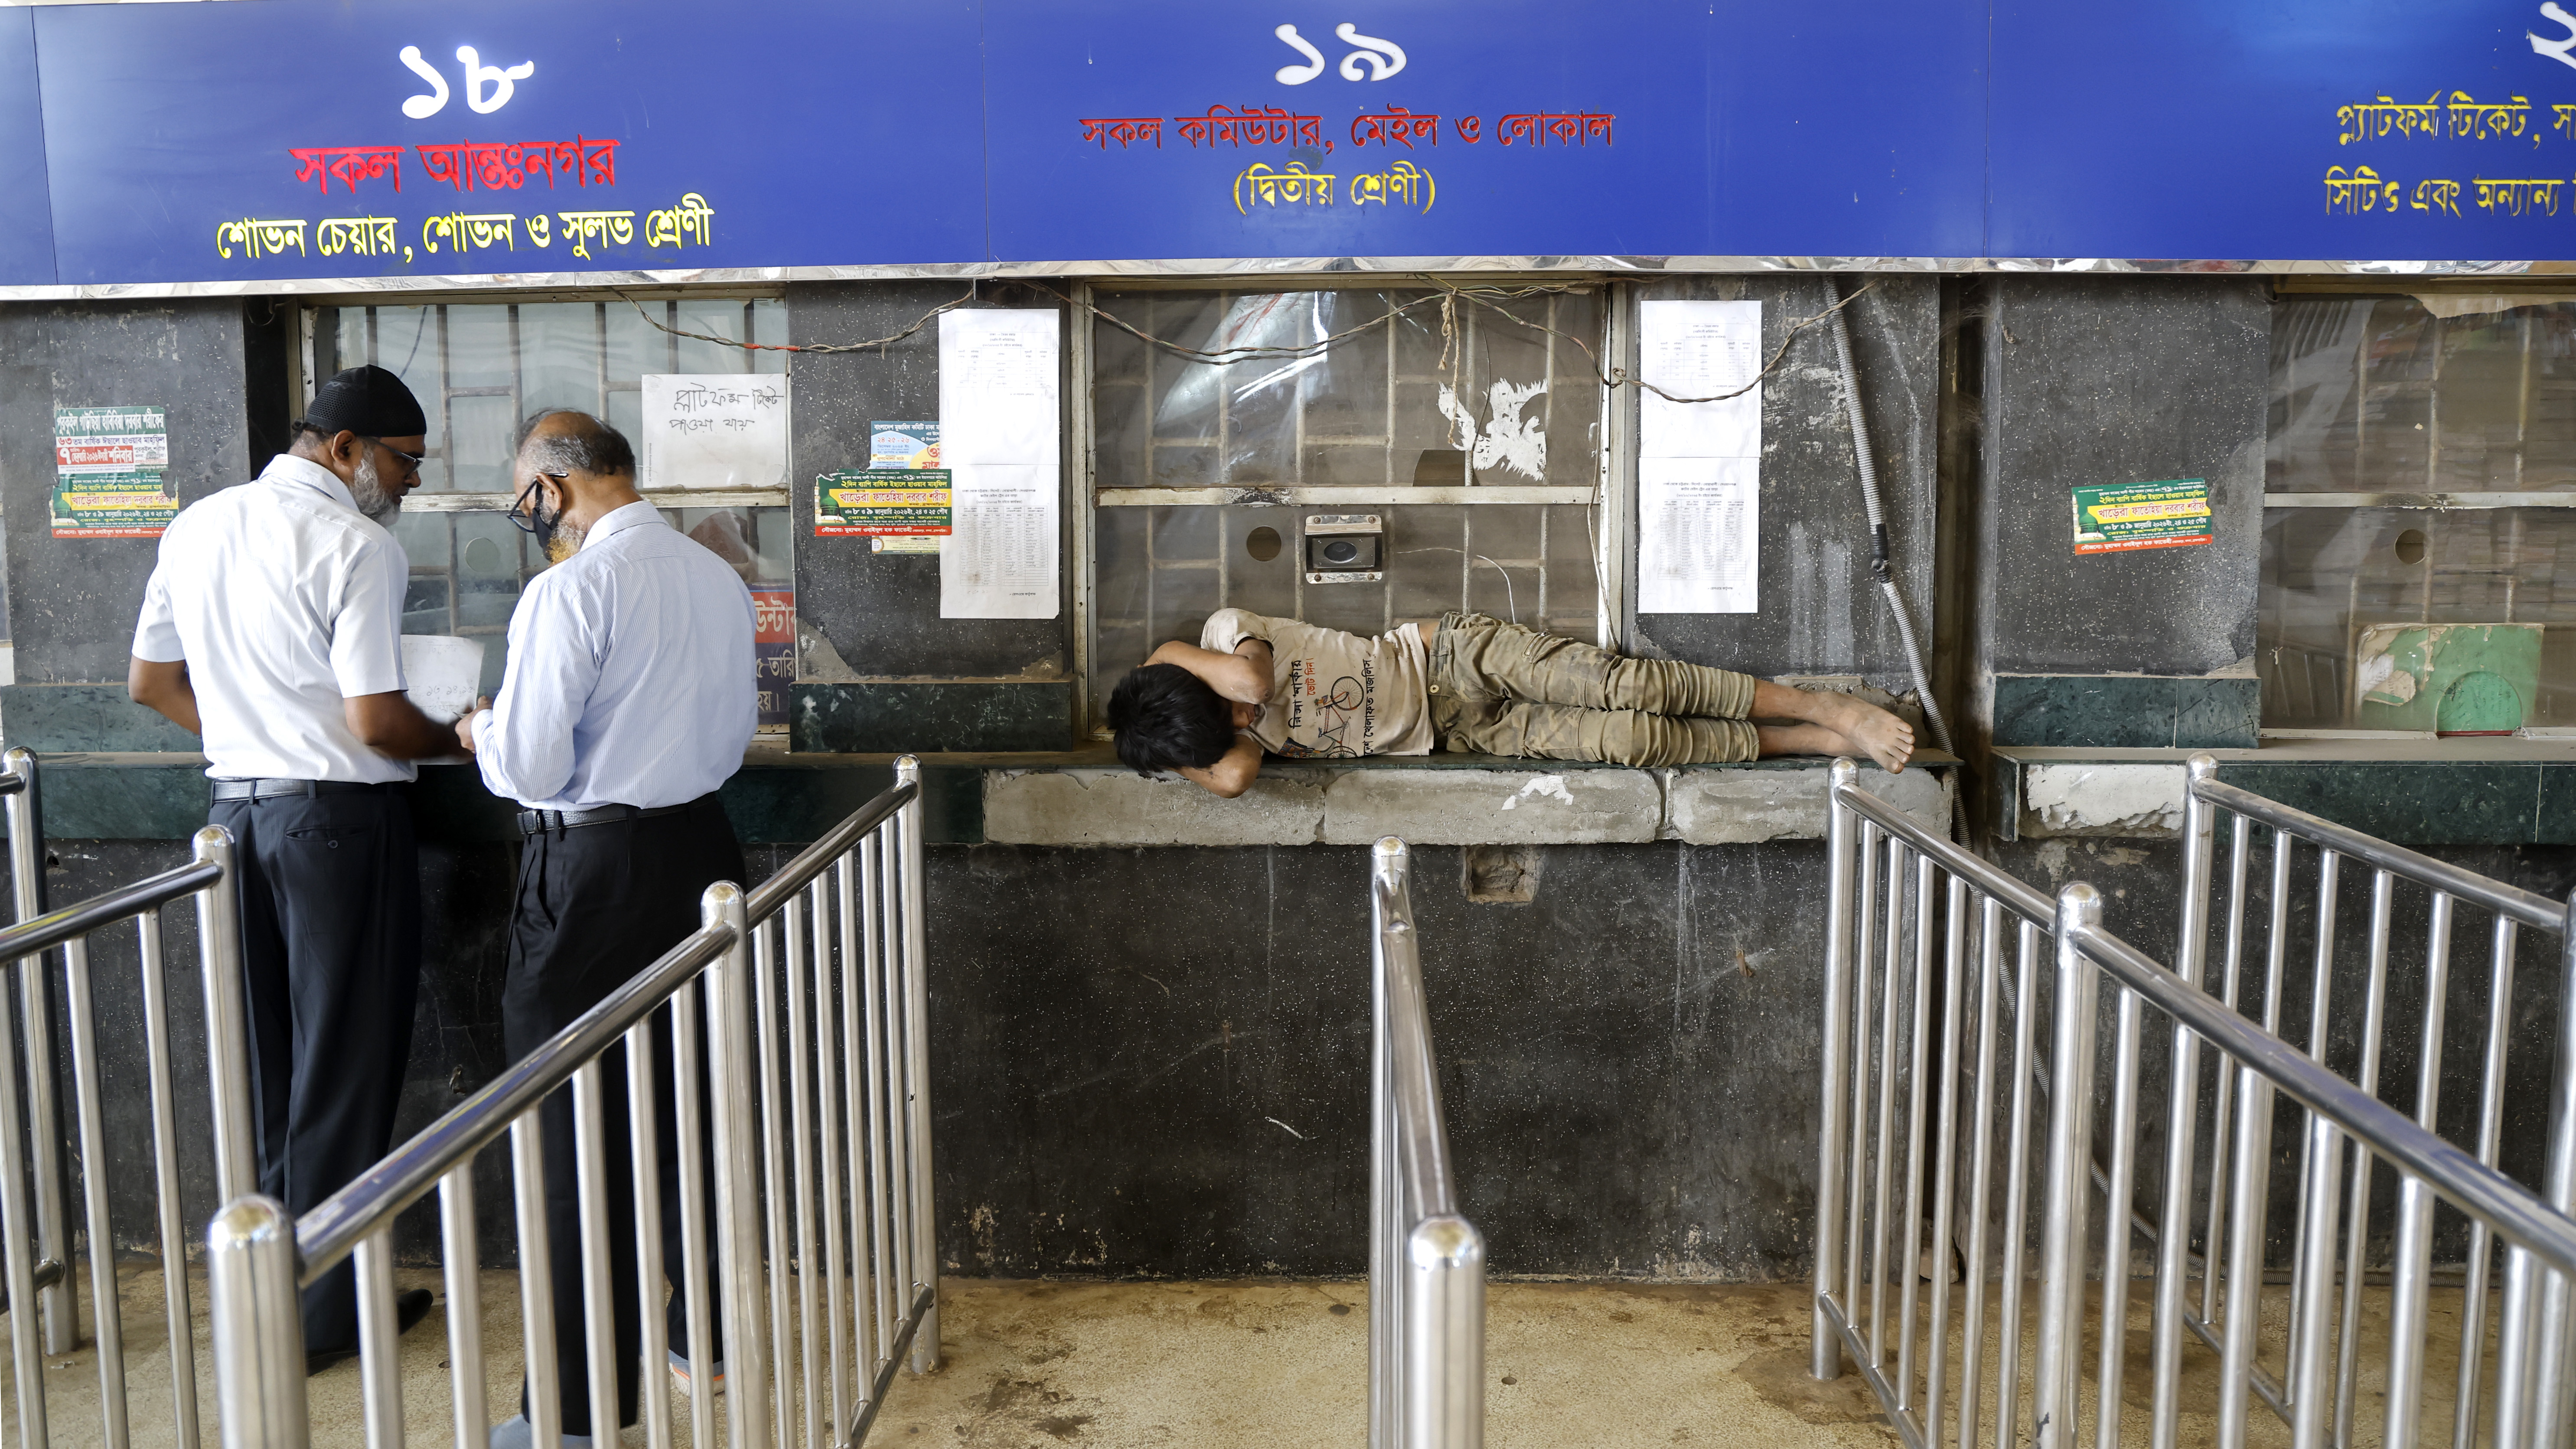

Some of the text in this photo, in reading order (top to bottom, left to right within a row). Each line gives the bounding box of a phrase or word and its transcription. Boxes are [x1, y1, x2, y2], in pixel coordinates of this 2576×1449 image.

[1275, 22, 1407, 85] ১৯
[400, 46, 535, 119] ১৮
[1078, 102, 1616, 156] সকল কমিউটার, মেইল ও লোকাল
[2337, 89, 2441, 145] প্ল্যাটফর্ম
[2447, 90, 2540, 149] টিকেট,
[288, 134, 620, 194] সকল আন্তঃনগর
[1233, 160, 1435, 216] (দ্বিতীয় শ্রেণী)
[2410, 179, 2462, 219] এবং
[2472, 174, 2565, 216] অন্যান্য
[217, 193, 714, 263] শোভন চেয়ার, শোভন ও সুলভ শ্রেণী
[895, 423, 910, 432] মুজাহিদ
[134, 495, 153, 505] দরবার
[873, 490, 903, 502] ফাতেহিয়া
[906, 492, 926, 502] দরবার
[929, 489, 947, 502] শরীফ
[2131, 503, 2162, 516] ফাতেহিয়া
[2165, 503, 2185, 513] দরবার
[2187, 500, 2205, 512] শরীফ
[767, 649, 796, 678] তারি
[1361, 659, 1374, 694] মজলিস
[1304, 678, 1316, 696] ভোট
[1363, 696, 1375, 738] খেলাফত
